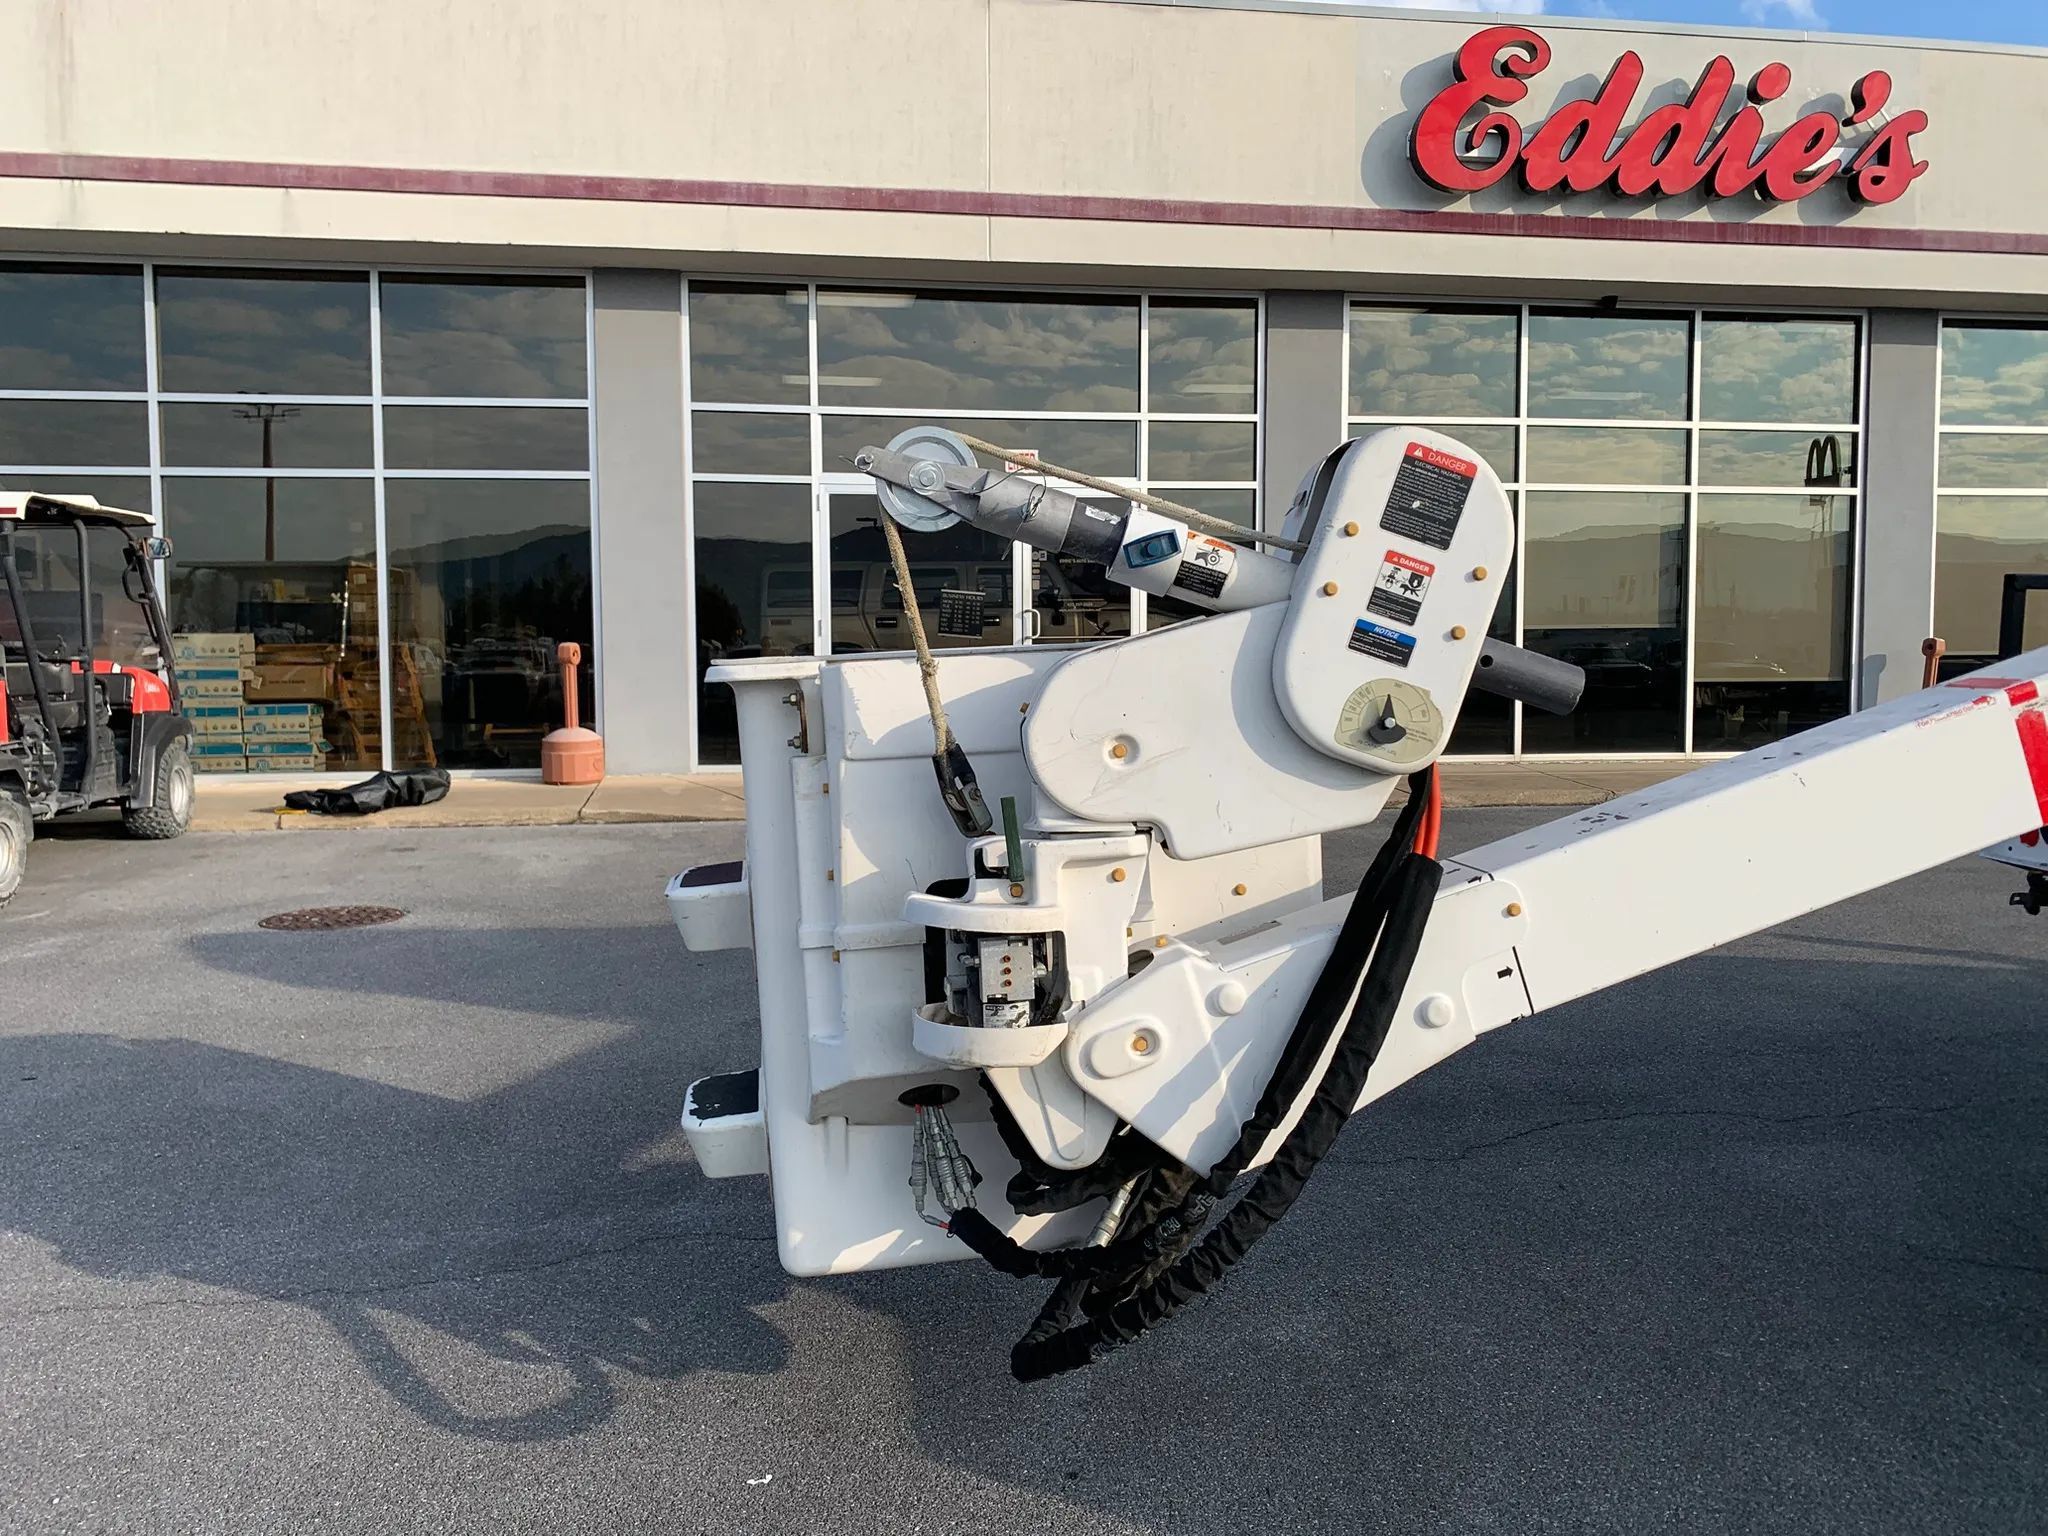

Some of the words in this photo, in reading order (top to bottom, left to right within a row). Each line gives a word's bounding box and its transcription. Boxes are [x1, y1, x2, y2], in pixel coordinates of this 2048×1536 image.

[1411, 26, 1928, 205] Eddie's
[1428, 452, 1467, 472] DANGER
[1399, 557, 1430, 573] DANGER
[1373, 626, 1400, 639] NOTICE
